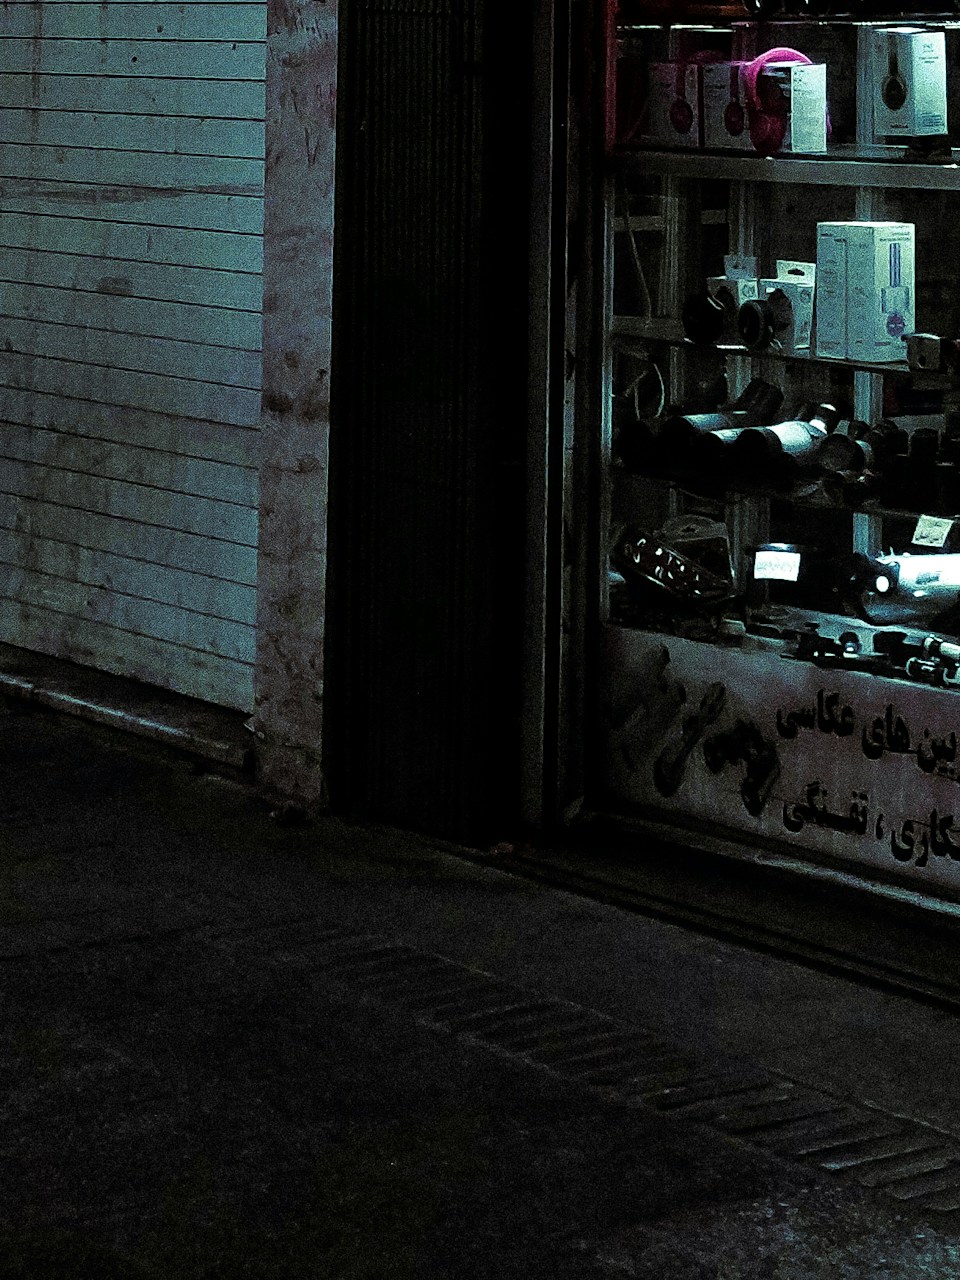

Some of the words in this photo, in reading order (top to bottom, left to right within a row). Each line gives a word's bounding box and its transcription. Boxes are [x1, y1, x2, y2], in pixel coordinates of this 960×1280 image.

[776, 688, 855, 741] عکاسی
[861, 703, 911, 761] های
[782, 780, 869, 836] تفنگی
